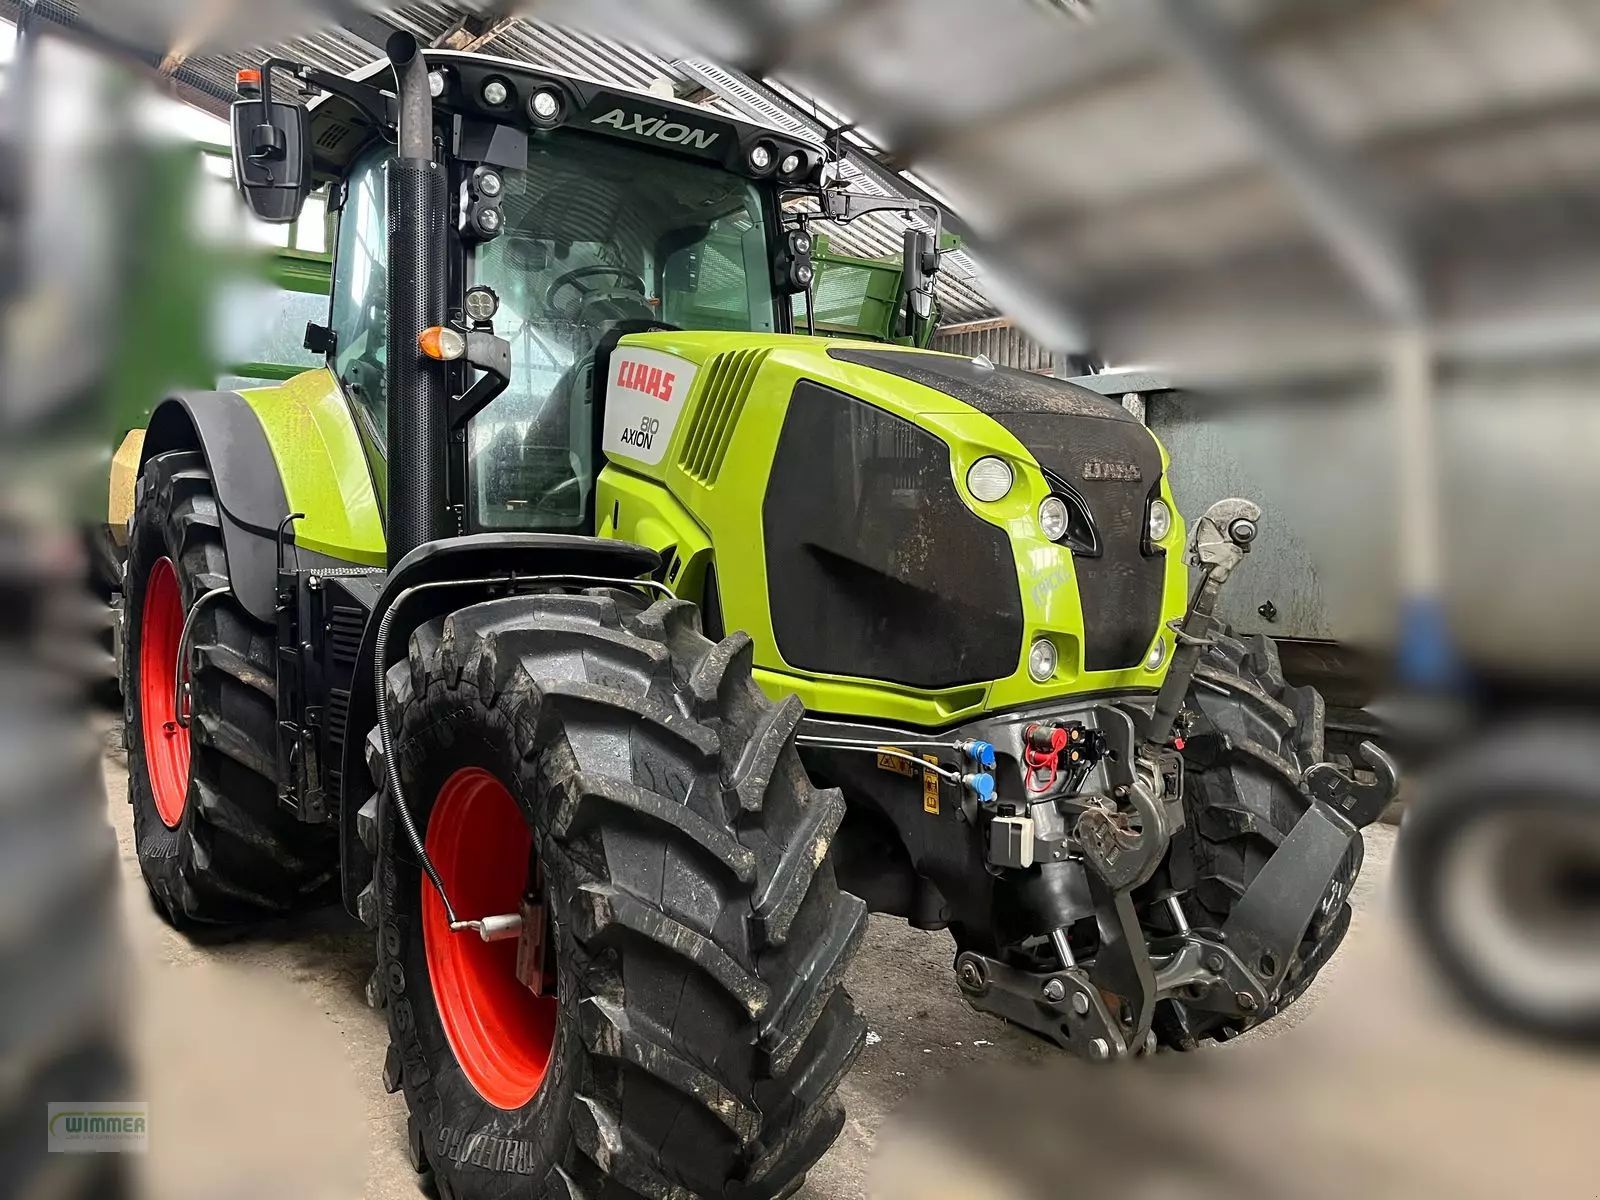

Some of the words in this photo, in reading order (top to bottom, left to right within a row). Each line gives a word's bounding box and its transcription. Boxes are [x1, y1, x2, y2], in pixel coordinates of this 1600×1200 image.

[591, 108, 720, 149] AXION
[617, 360, 675, 402] CLAAS
[620, 427, 653, 450] AXION
[640, 415, 660, 435] 810
